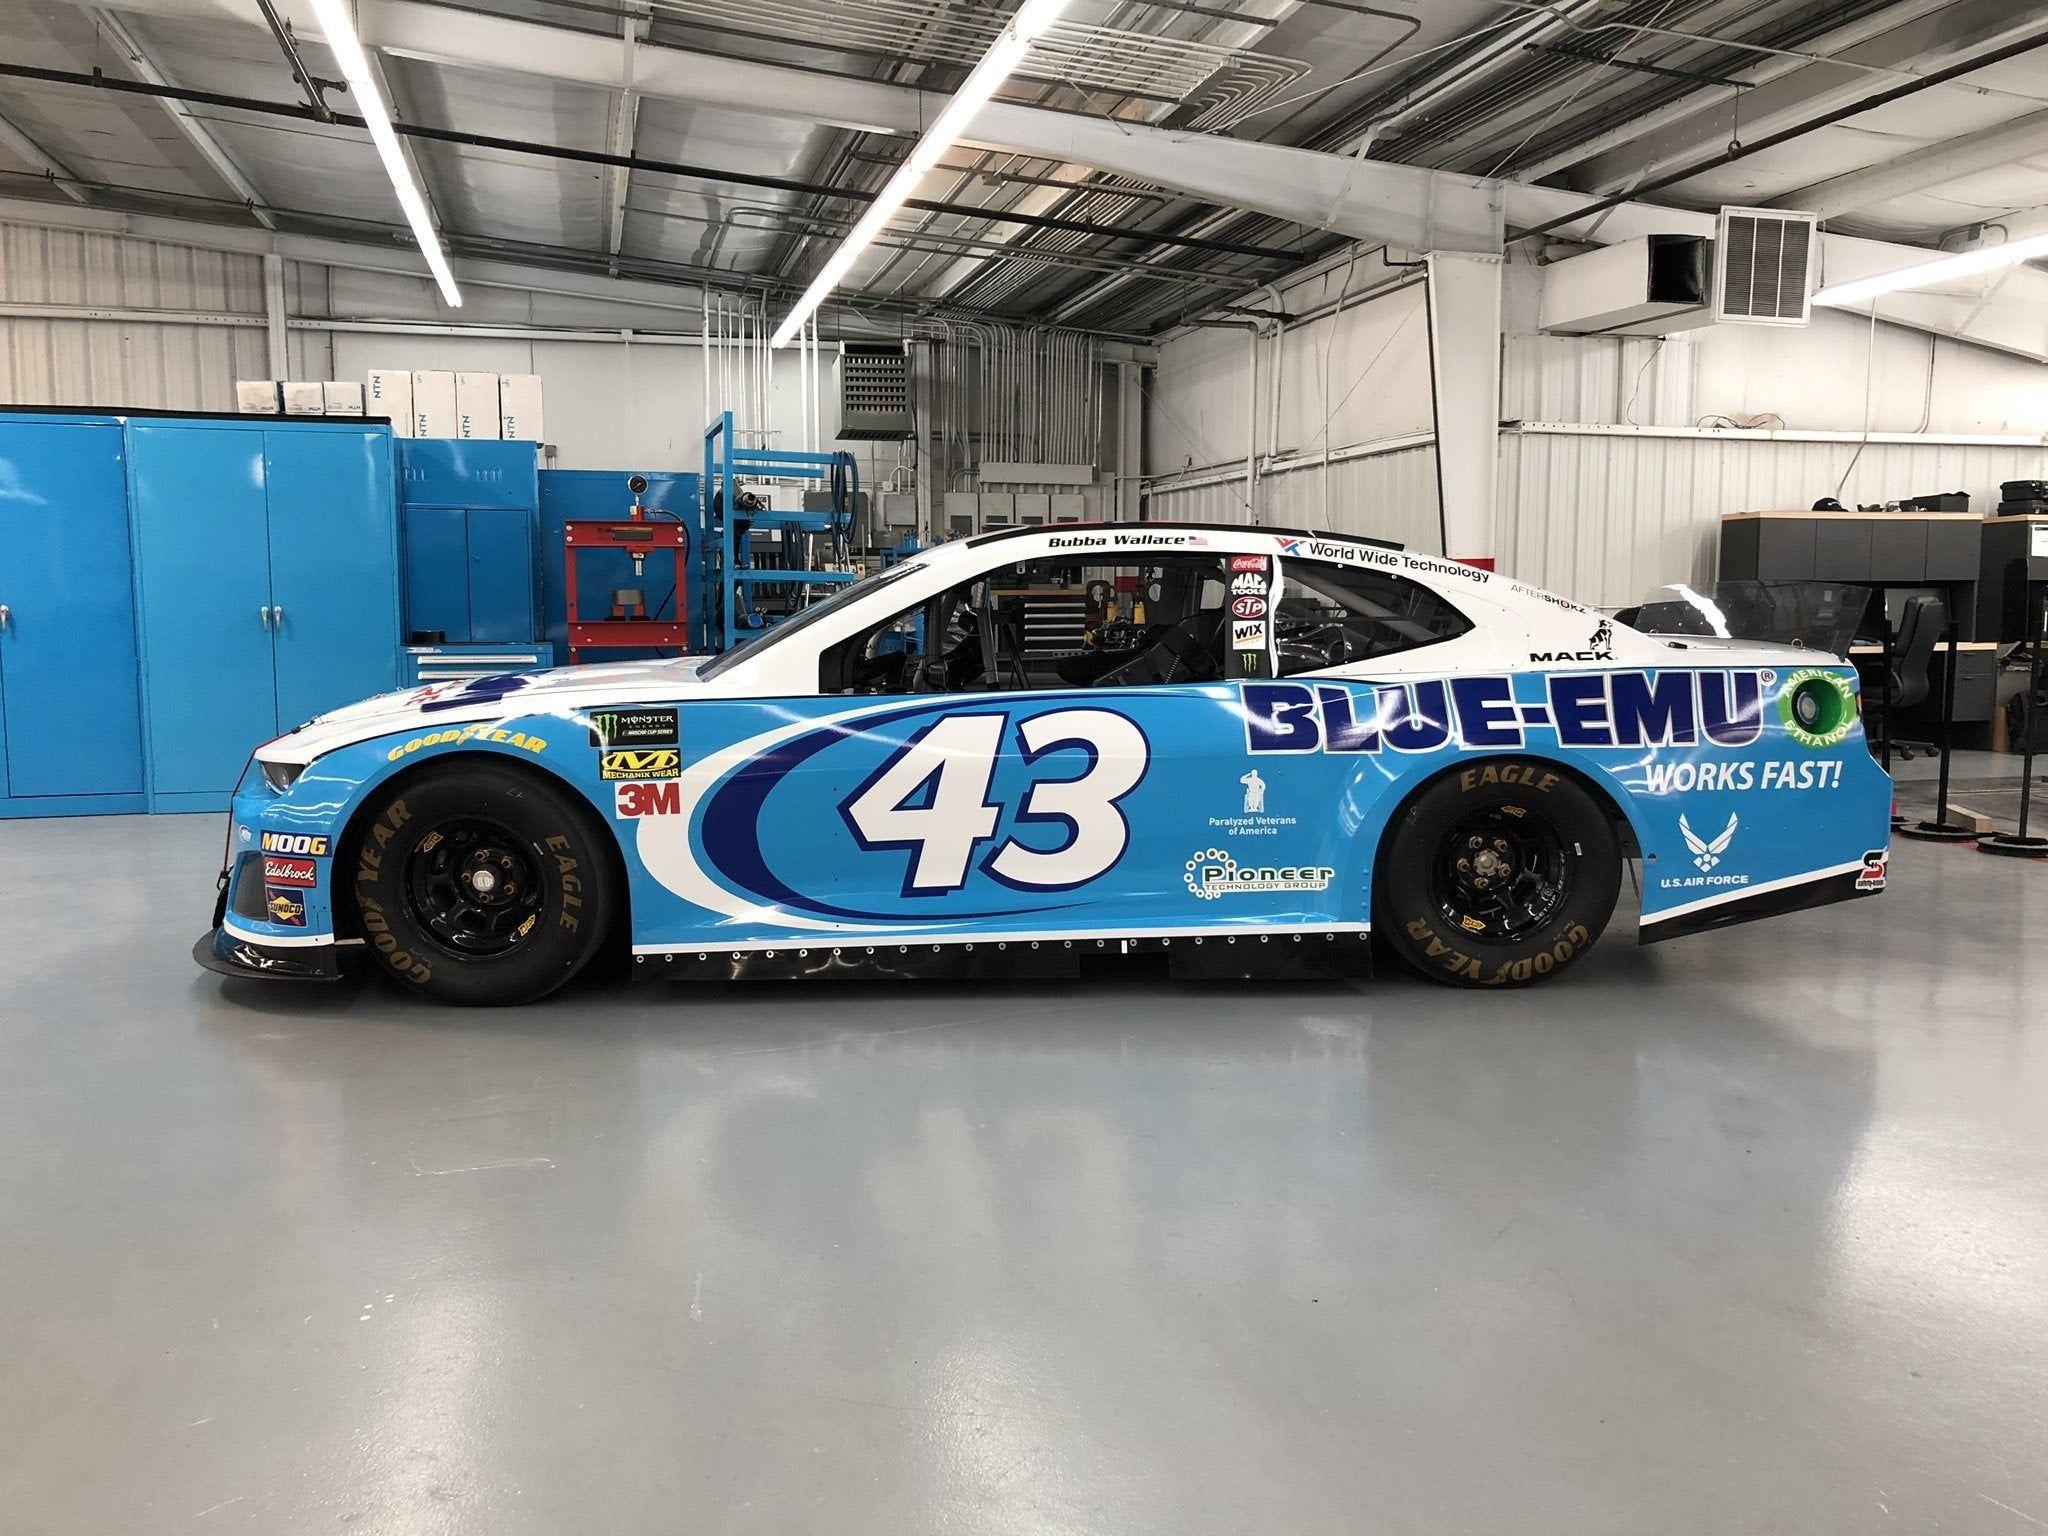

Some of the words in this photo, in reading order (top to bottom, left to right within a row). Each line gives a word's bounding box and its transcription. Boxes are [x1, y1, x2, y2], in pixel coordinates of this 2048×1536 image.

[373, 376, 381, 398] NTN
[419, 414, 427, 437] NTN
[462, 416, 470, 438] NTN
[507, 416, 516, 438] NTN
[1048, 536, 1107, 548] Bubba
[1114, 535, 1186, 545] Wallace
[1308, 543, 1354, 560] World
[1359, 550, 1398, 566] Wide
[1402, 556, 1490, 583] Technology
[1231, 573, 1267, 588] MAC
[1236, 599, 1262, 615] STP
[1510, 584, 1587, 614] AFTERSHOKZ
[1235, 623, 1262, 640] WIX
[1530, 652, 1614, 662] MACK
[1782, 668, 1853, 698] AMERICAN
[621, 715, 674, 724] MONSTER
[388, 724, 547, 762] GOODYEAR
[1784, 720, 1854, 746] ETHANOL
[602, 770, 650, 779] MECHANIX
[652, 768, 679, 778] WEAR
[1460, 764, 1560, 792] EAGLE
[1645, 762, 1755, 792] WORKS
[1760, 760, 1843, 790] FAST!
[618, 782, 680, 816] 3M
[836, 706, 1151, 898] 43
[1208, 817, 1254, 827] Paralyzed
[1256, 816, 1296, 826] Veterans
[1228, 826, 1238, 836] of
[1239, 826, 1278, 835] America
[262, 832, 328, 856] MOOG
[265, 861, 315, 880] Edelbrock
[1204, 867, 1333, 882] Pioneer
[1660, 877, 1682, 888] U.S.
[1684, 876, 1704, 887] AIR
[1706, 875, 1749, 886] FORCE
[544, 834, 582, 934] EAGLE
[1206, 882, 1281, 891] TECHNOLOGY
[1284, 882, 1326, 890] GROUP
[270, 902, 302, 914] SUNOCO
